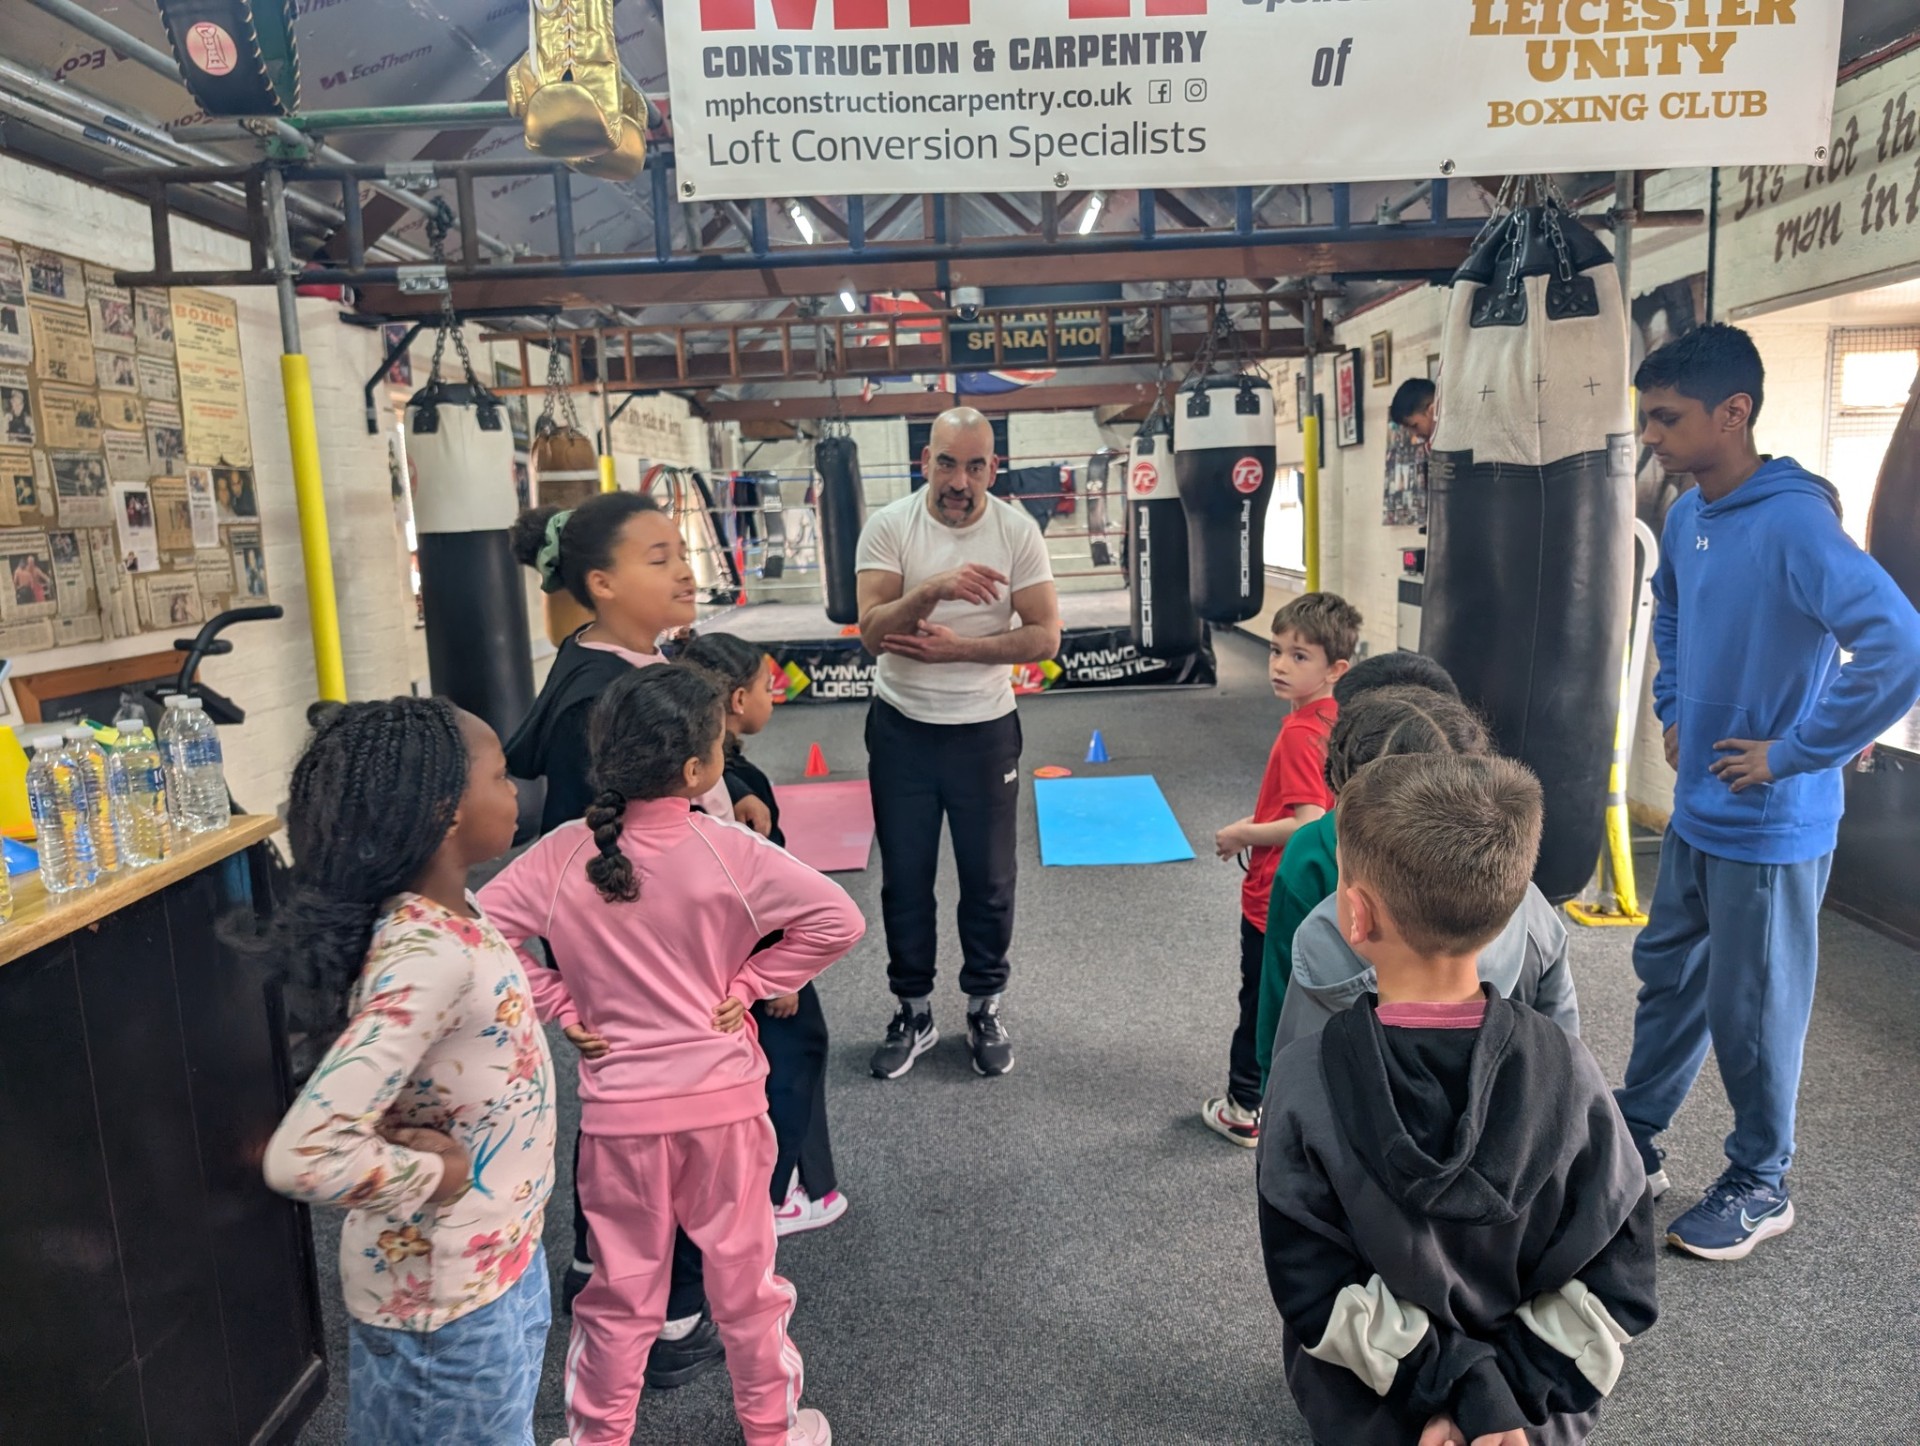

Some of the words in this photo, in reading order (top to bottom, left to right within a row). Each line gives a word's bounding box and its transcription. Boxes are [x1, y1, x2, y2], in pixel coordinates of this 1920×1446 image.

[1469, 0, 1796, 36] LEICESTER
[350, 44, 433, 81] EcoTherm
[702, 42, 960, 79] CONSTRUCTION
[972, 39, 996, 73] &
[1008, 30, 1208, 72] CARPENTRY
[1310, 37, 1354, 88] of
[1525, 31, 1738, 83] UNITY
[705, 81, 1132, 123] mphconstructioncarpentry.co.uk
[1486, 93, 1649, 129] BOXING
[1659, 89, 1768, 120] CLUB
[707, 129, 782, 167] Loft
[791, 128, 998, 163] Conversion
[1008, 120, 1207, 167] Specialists
[1876, 91, 1920, 164] th
[1774, 201, 1844, 264] man
[1860, 172, 1899, 236] in
[174, 304, 235, 330] BOXING
[1239, 499, 1252, 598] RINGSIDE
[1138, 505, 1154, 648] RINGSIDE
[1061, 645, 1142, 671] WYNWO
